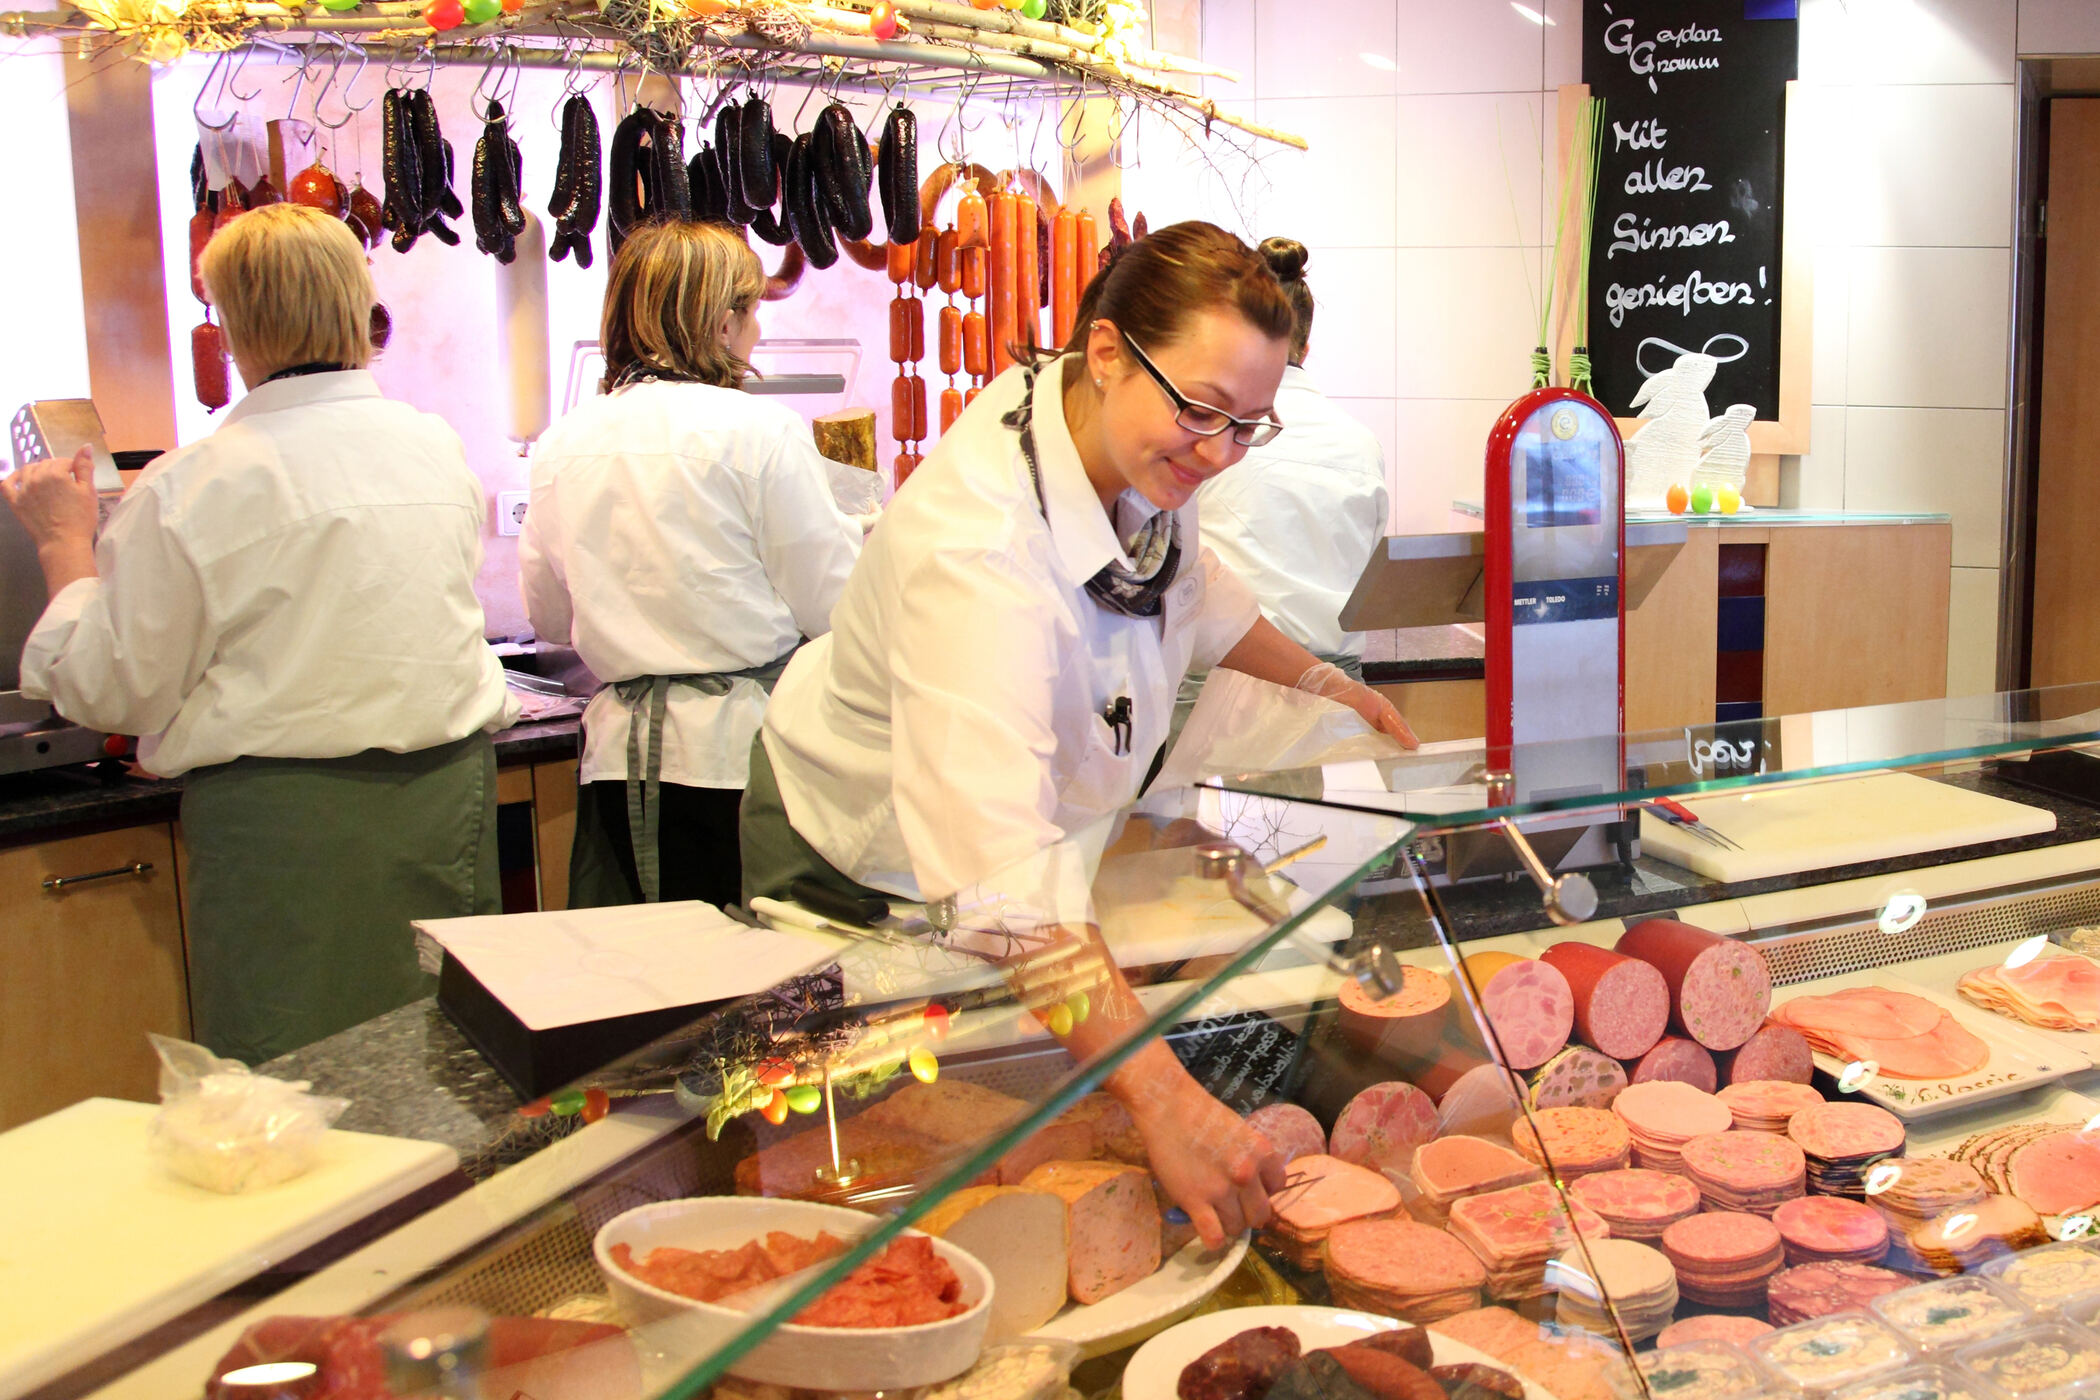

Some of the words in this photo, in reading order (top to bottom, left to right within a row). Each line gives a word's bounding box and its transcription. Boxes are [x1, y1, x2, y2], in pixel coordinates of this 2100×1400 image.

[1613, 119, 1667, 153] Mit
[1624, 158, 1713, 195] allen
[1607, 212, 1736, 260] Sinnen
[1605, 266, 1773, 329] genießen!
[1514, 597, 1537, 606] METTLER
[1546, 595, 1566, 604] TOLEDO
